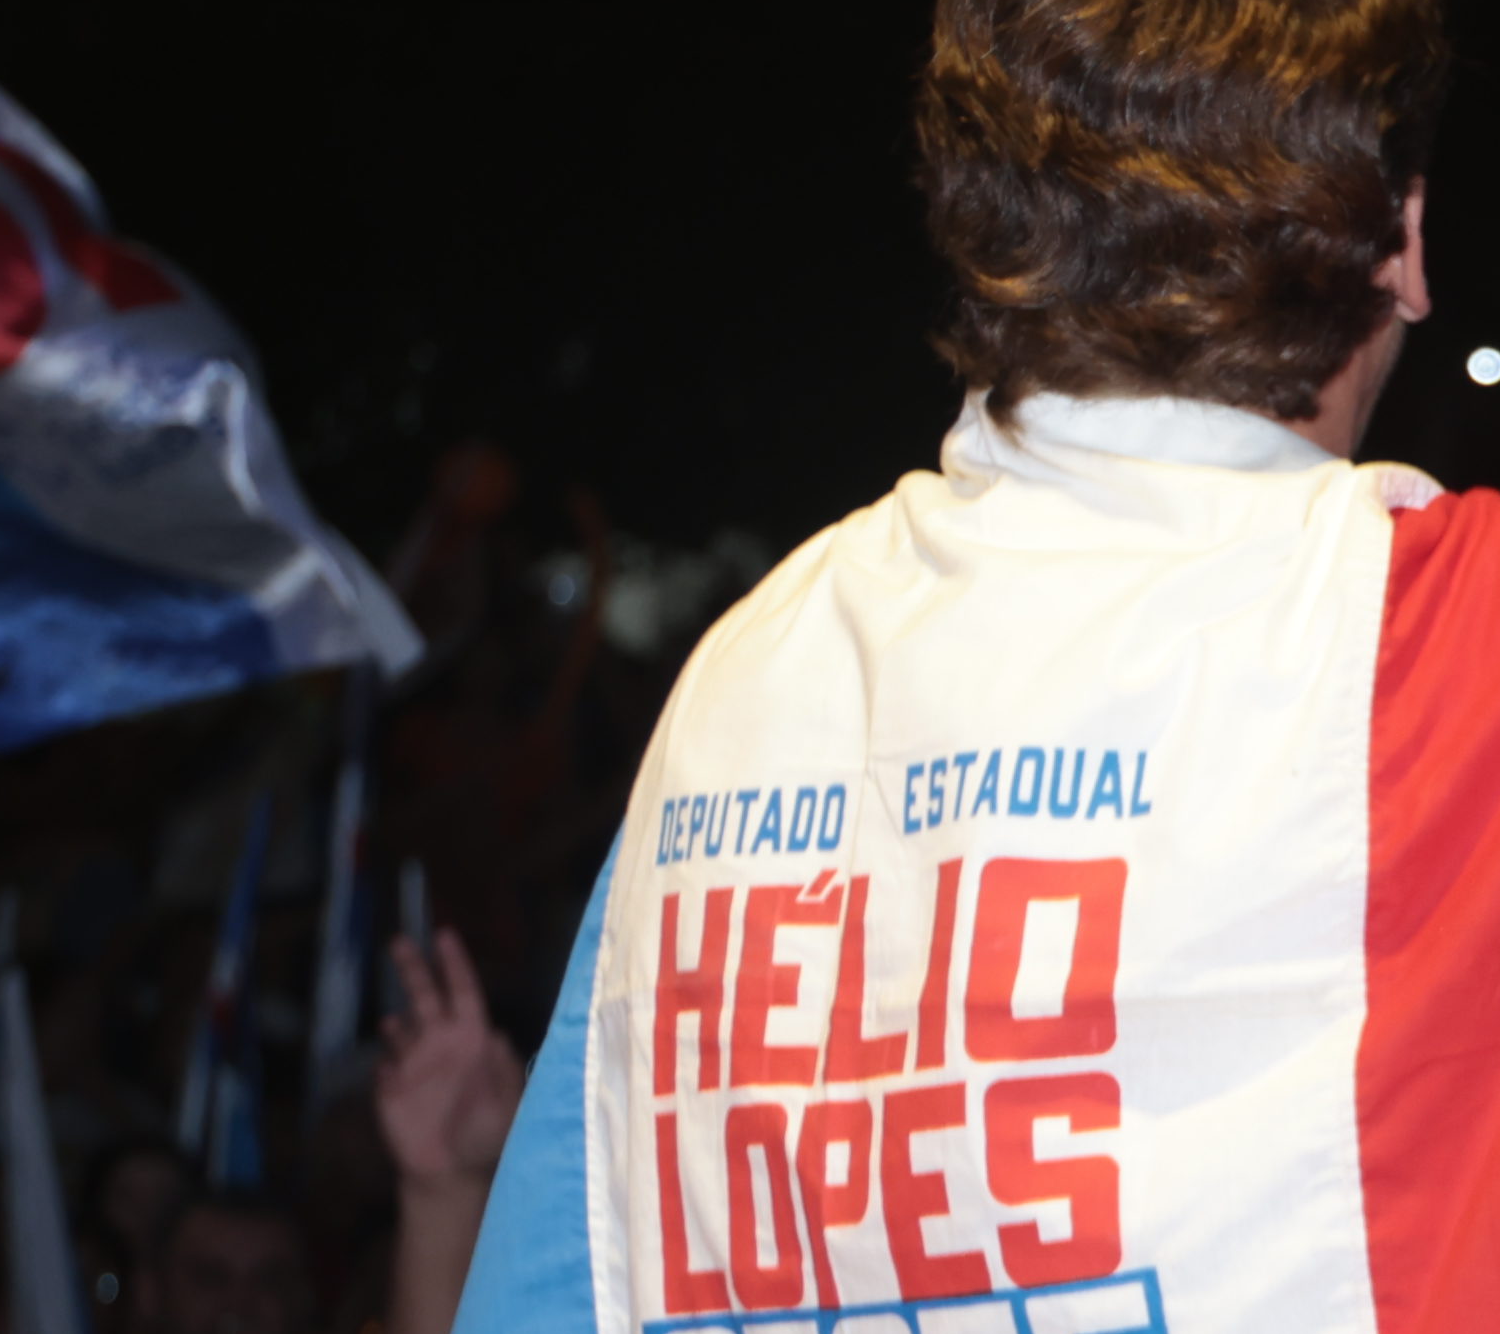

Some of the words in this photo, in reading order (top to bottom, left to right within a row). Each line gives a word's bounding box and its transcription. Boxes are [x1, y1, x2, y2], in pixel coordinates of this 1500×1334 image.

[656, 783, 848, 867] DEPUTADO
[903, 747, 1154, 834] ESTADUAL
[653, 856, 1129, 1097] HÉLIO
[654, 1070, 1123, 1314] LOPES
